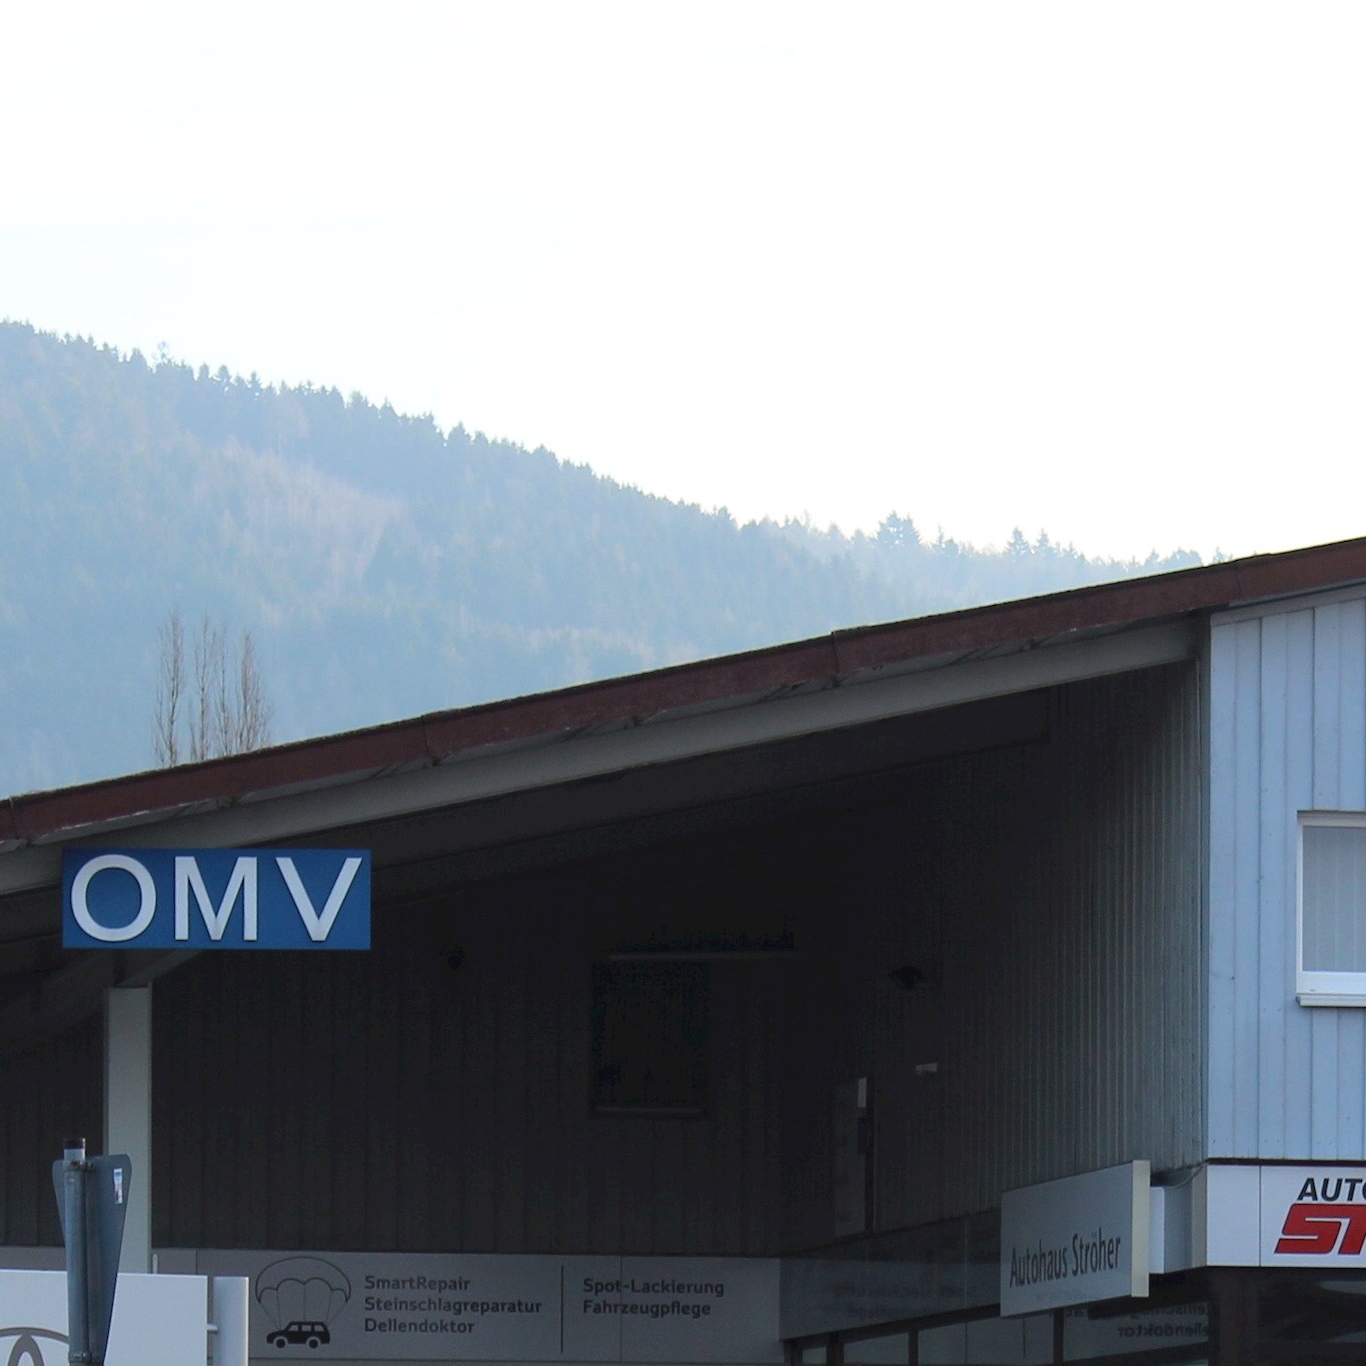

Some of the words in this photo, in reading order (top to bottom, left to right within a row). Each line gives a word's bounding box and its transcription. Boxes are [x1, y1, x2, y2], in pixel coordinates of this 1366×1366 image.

[70, 853, 363, 942] OMV
[1009, 1237, 1068, 1287] Autohaus
[1071, 1227, 1122, 1275] Ströher
[364, 1275, 471, 1293] SmartRepair
[583, 1278, 725, 1297] Spot-Lackierung
[364, 1297, 542, 1315] Steinschlagreparatur
[583, 1300, 711, 1318] Fahrzeugpflege
[364, 1318, 475, 1333] Dellendoktor
